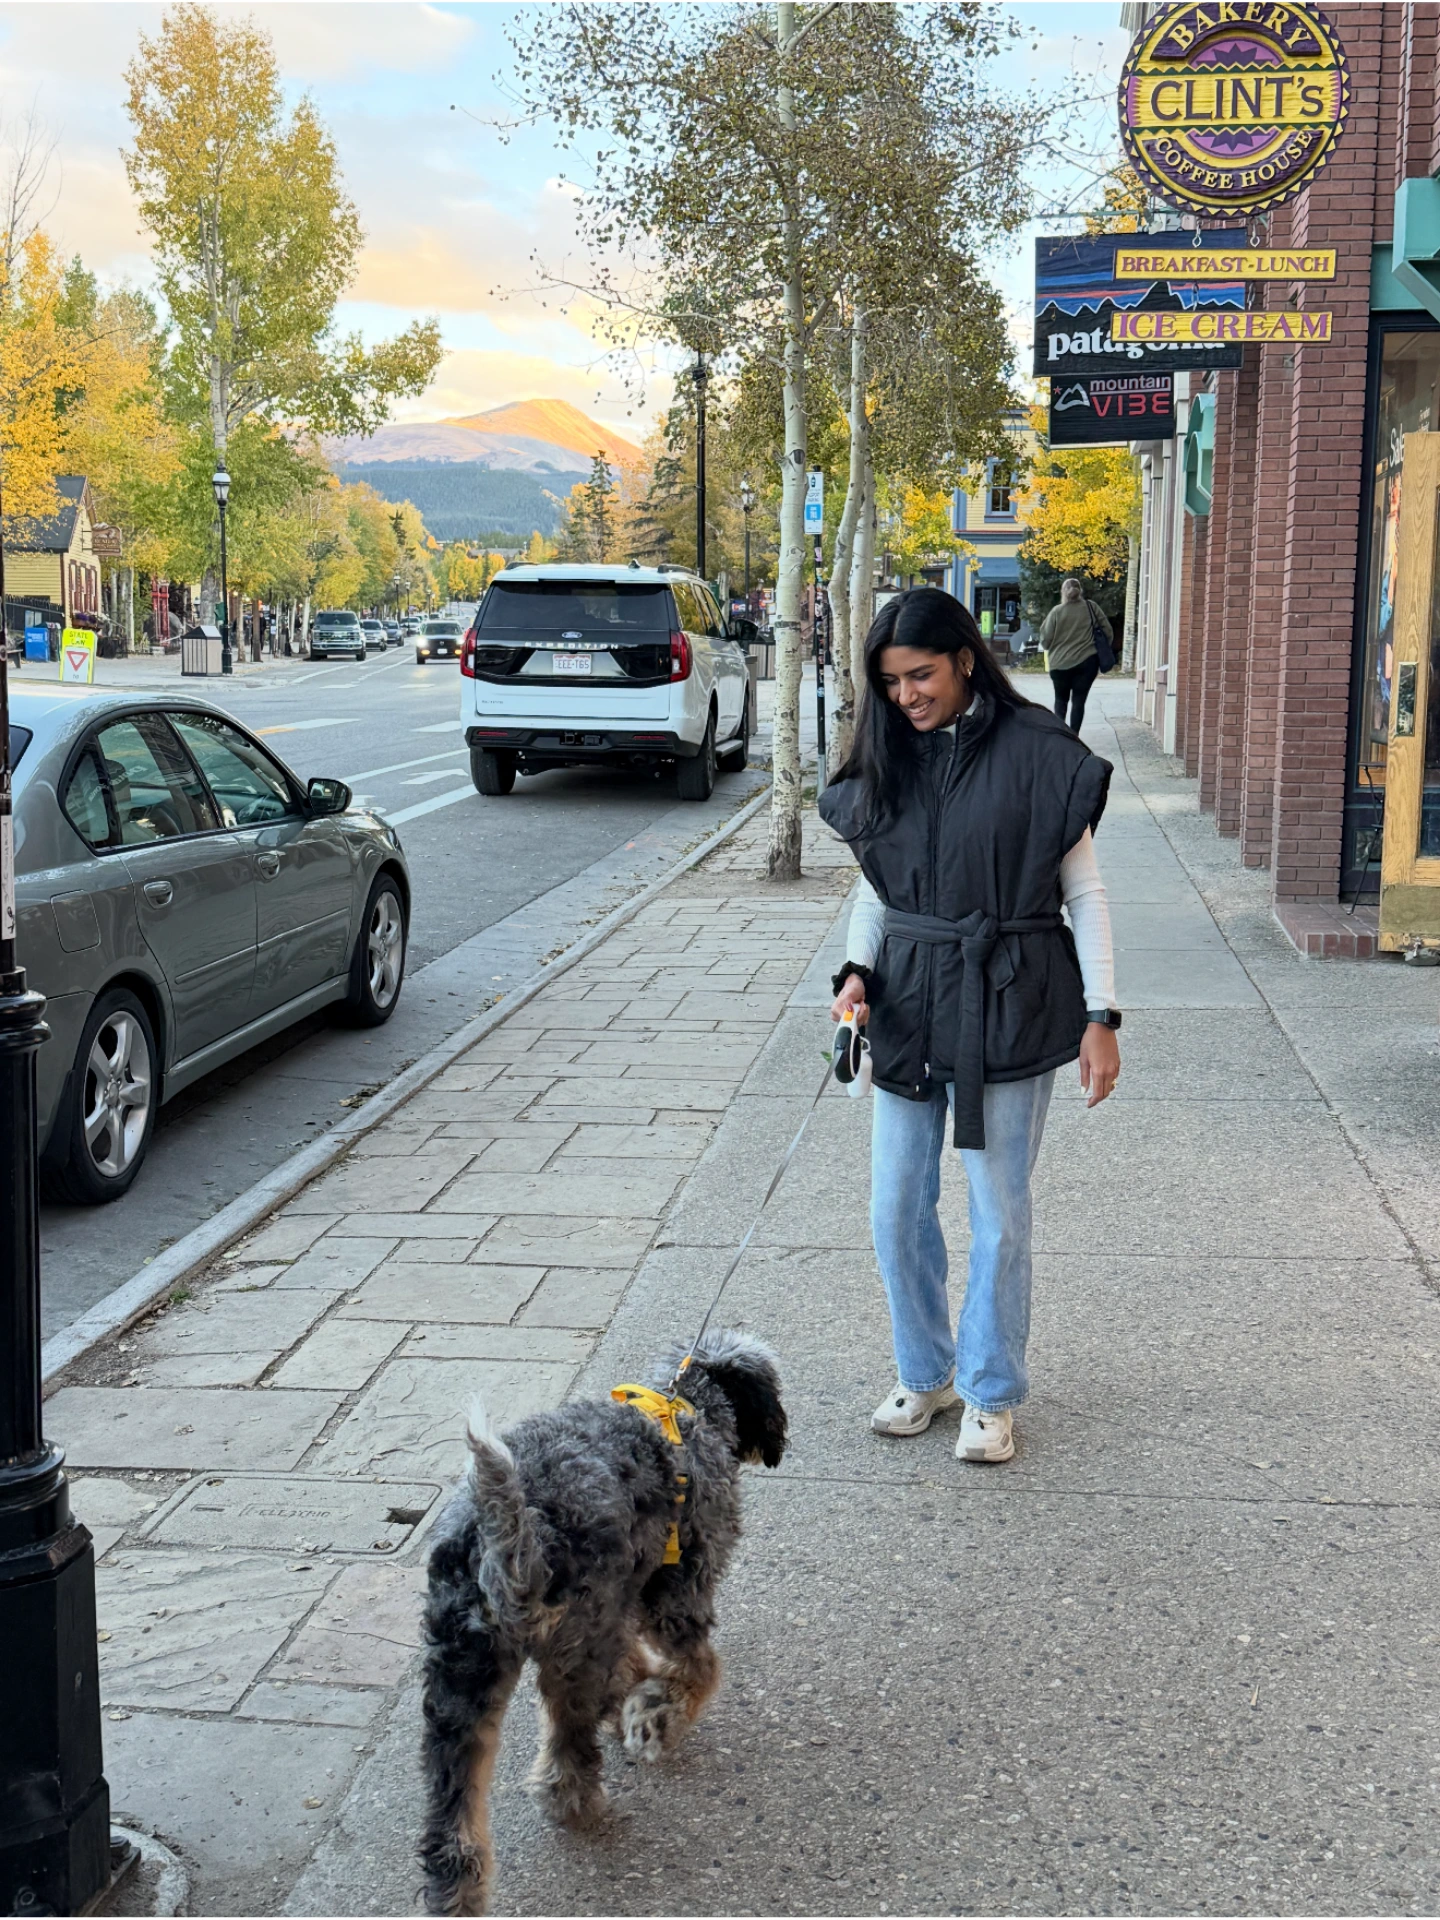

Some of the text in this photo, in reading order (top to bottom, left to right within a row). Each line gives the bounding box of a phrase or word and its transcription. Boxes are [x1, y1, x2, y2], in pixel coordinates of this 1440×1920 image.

[1168, 2, 1312, 51] BAKERY
[1151, 75, 1324, 121] CLINT's
[1155, 130, 1313, 189] COFFEE HOUSE
[1121, 256, 1329, 272] BREAKFAST-LUNCH
[1116, 313, 1328, 339] ICE CREAM
[1090, 374, 1172, 391] mountain
[1092, 392, 1170, 417] VIBE
[69, 631, 88, 639] STATE
[524, 641, 619, 650] EXPEDITION
